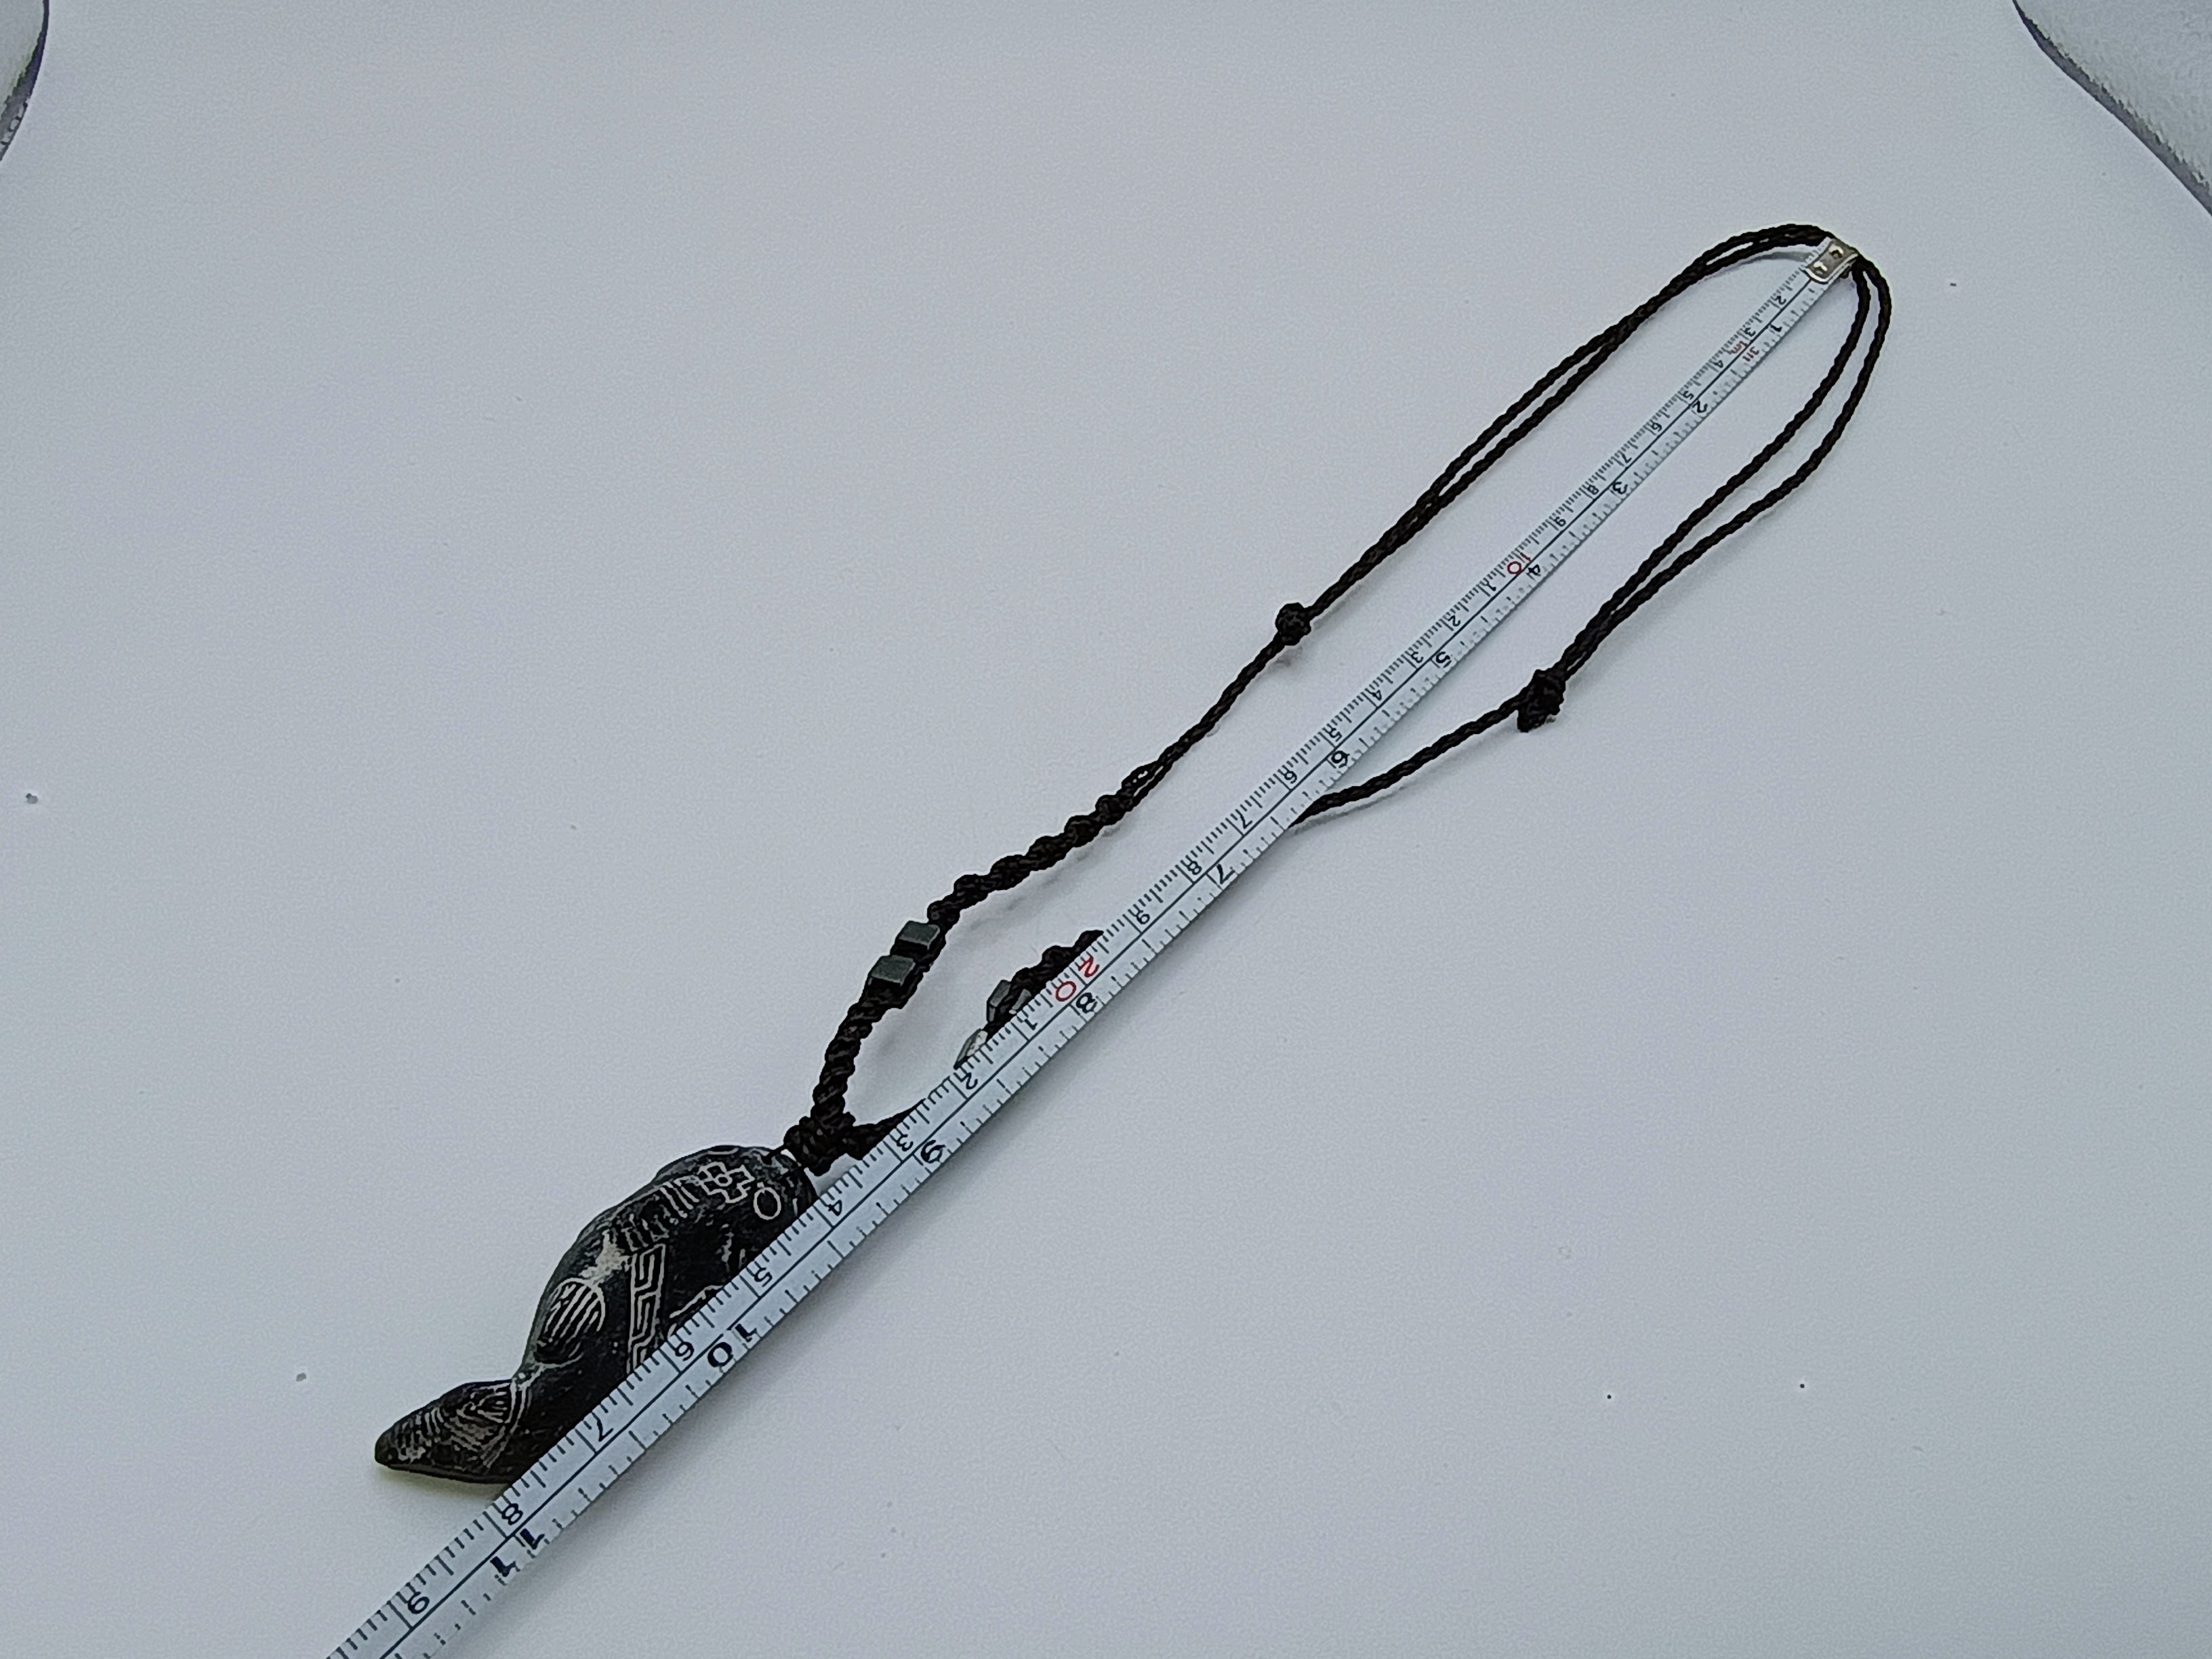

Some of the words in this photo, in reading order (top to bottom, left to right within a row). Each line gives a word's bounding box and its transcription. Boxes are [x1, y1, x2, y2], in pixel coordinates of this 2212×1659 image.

[1692, 401, 1708, 413] 2
[1612, 481, 1628, 495] 3
[1507, 552, 1532, 575] 10
[1436, 651, 1452, 668] 5
[1328, 727, 1343, 742] 5
[1330, 750, 1351, 769] 6
[1187, 859, 1202, 876] 8
[1216, 863, 1236, 884] 7
[1135, 909, 1151, 925] 9
[1055, 956, 1100, 1002] 20
[1076, 992, 1099, 1014] 8
[1023, 1018, 1038, 1031] 1
[962, 1072, 978, 1090] 2
[896, 1133, 914, 1152] 3
[920, 1139, 946, 1164] 9
[827, 1199, 843, 1216] 4
[753, 1267, 773, 1287] 5
[674, 1341, 695, 1361] 6
[707, 1323, 758, 1368] 10
[595, 1416, 614, 1442] 7
[501, 1502, 524, 1525] 8
[490, 1528, 545, 1577] 11
[407, 1590, 430, 1615] 9
